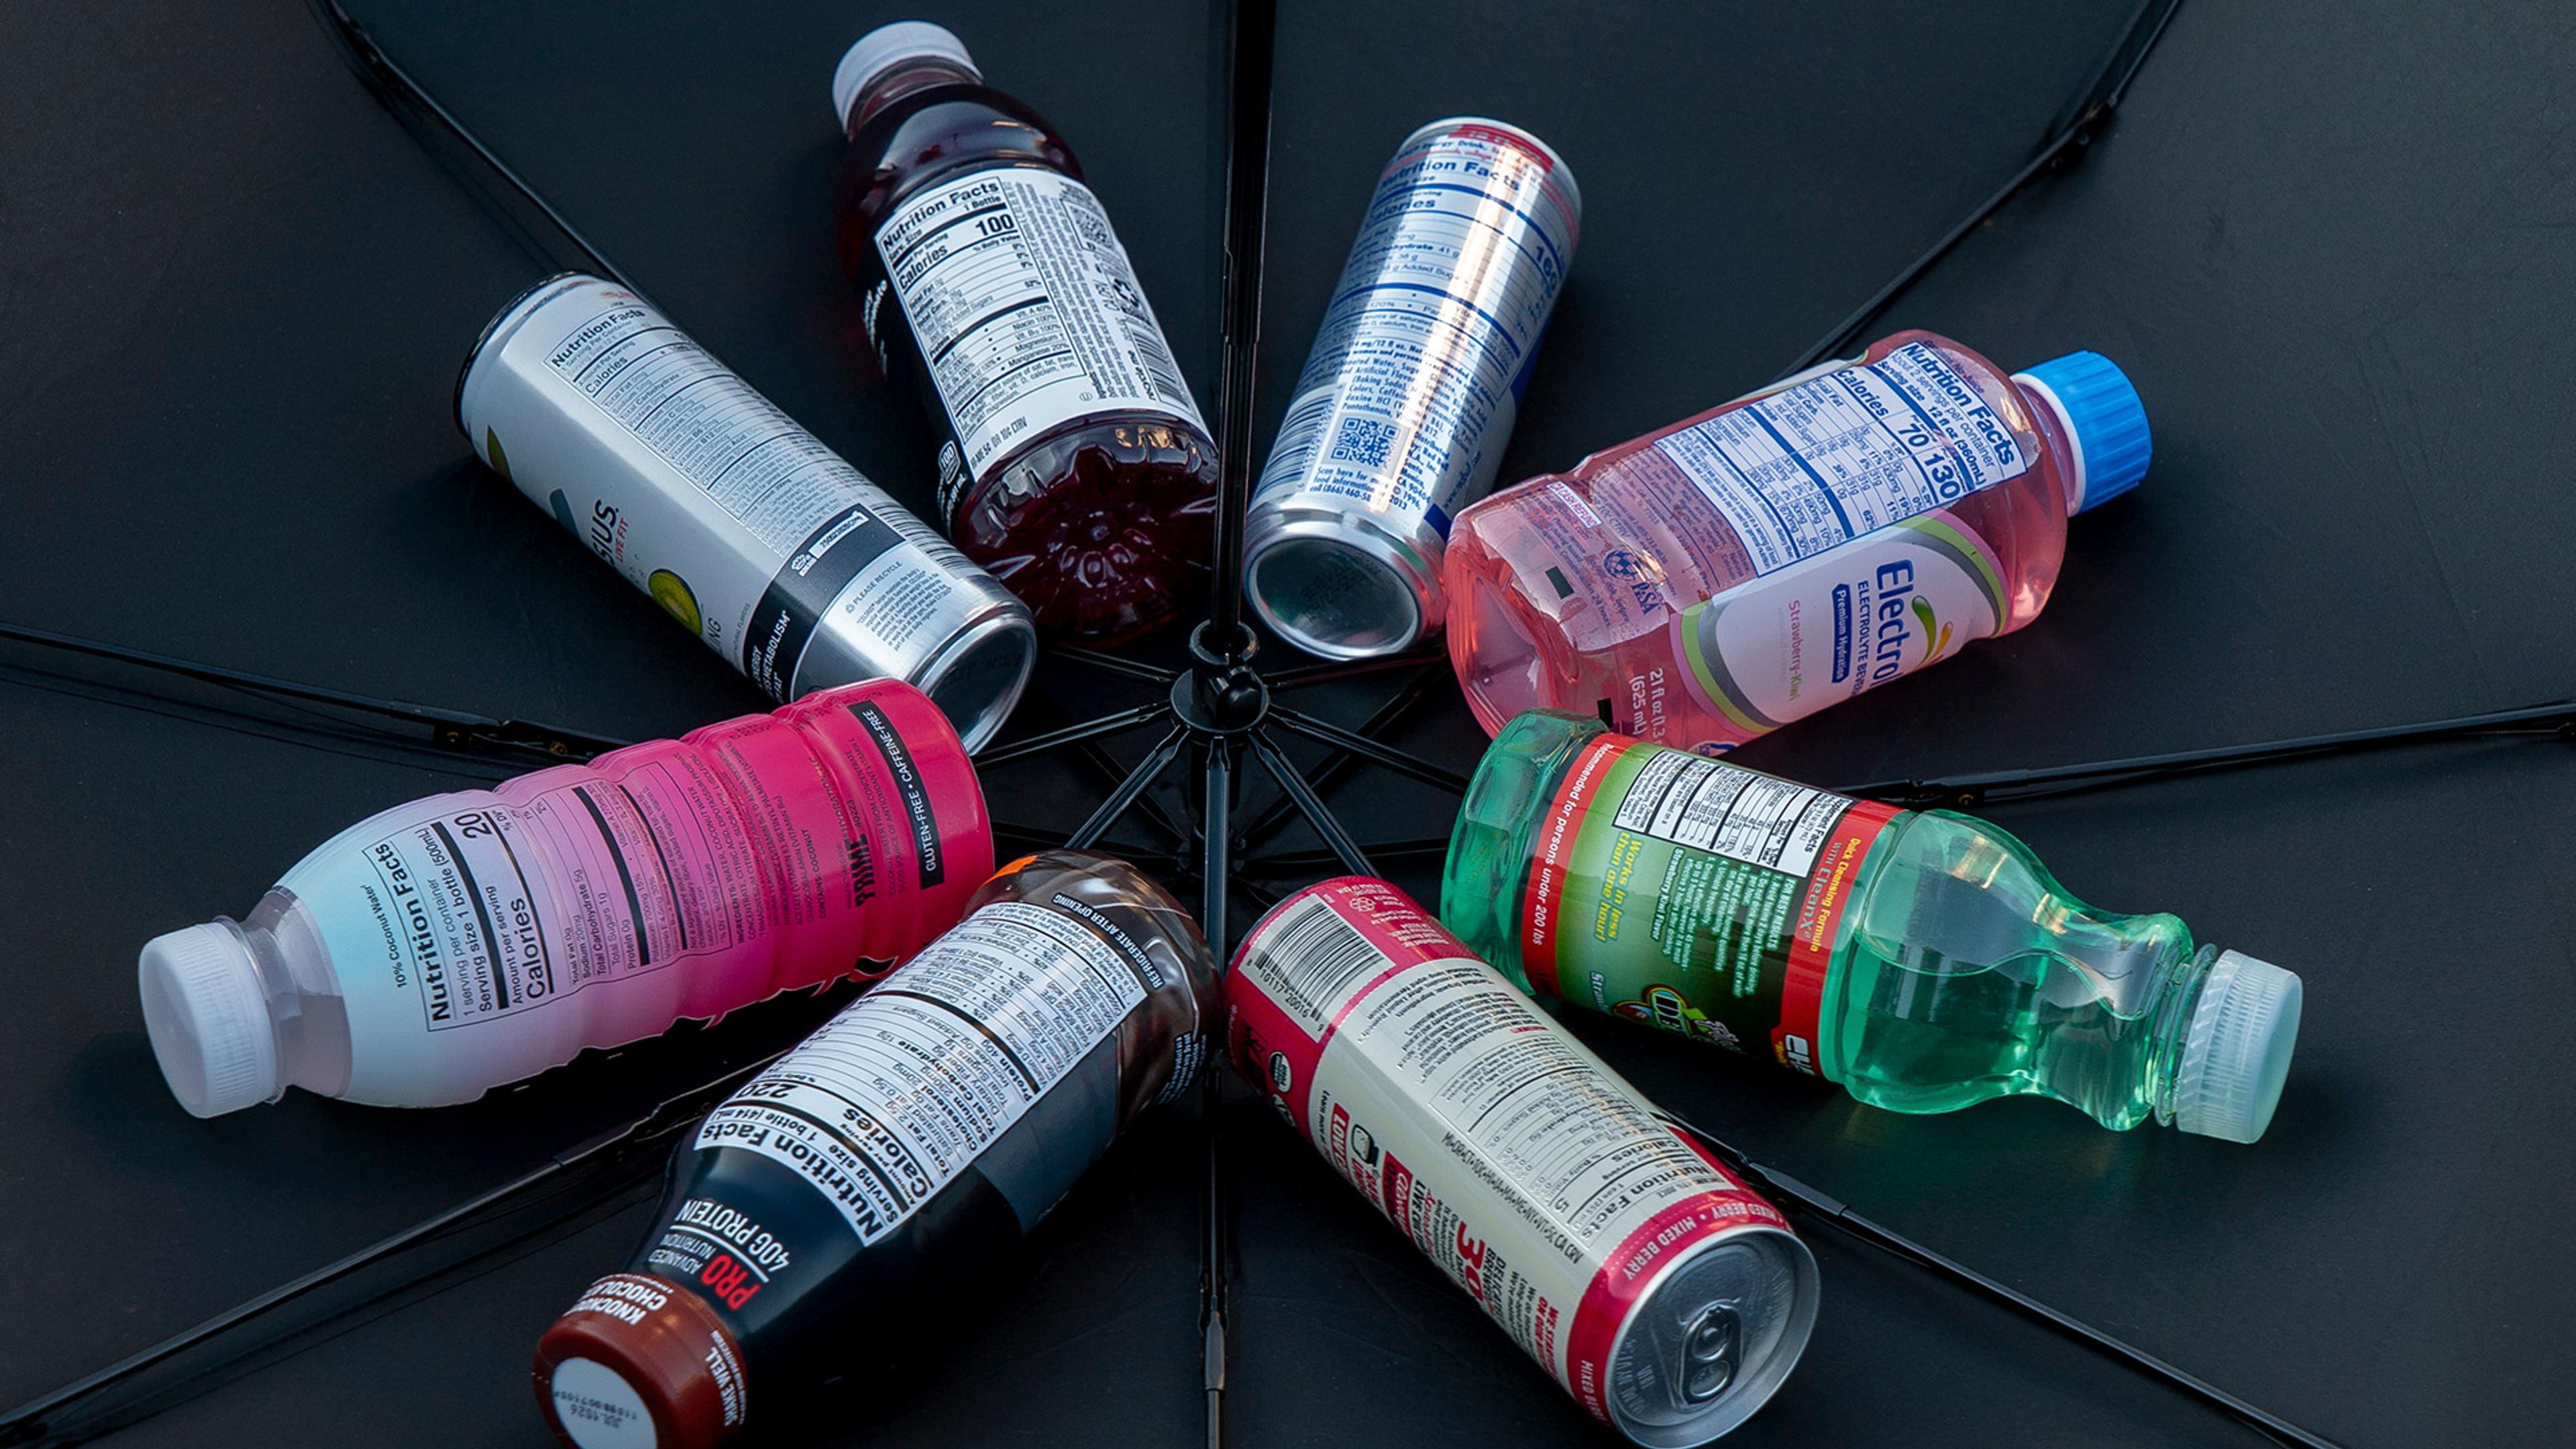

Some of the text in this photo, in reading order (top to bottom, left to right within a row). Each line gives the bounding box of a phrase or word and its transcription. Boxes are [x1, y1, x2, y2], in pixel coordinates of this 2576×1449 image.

[881, 180, 1000, 250] Nutrition Facts
[898, 211, 1016, 289] Calories 100
[551, 309, 645, 368] Nutrition Facts
[584, 354, 629, 394] Calories
[1837, 367, 1965, 502] Calories 70 130
[1901, 340, 2021, 467] Nutrition Facts
[1906, 382, 1957, 439] size 12 fl oz
[1915, 374, 1951, 409] servings
[1945, 406, 1964, 423] per
[1960, 420, 1997, 470] container
[1788, 600, 1801, 700] Strawberry-Kiwi
[1835, 589, 1849, 680] Premium Hydration
[1858, 580, 1868, 661] ELECTROLYTE
[1628, 675, 1648, 735] (625 mL)
[1649, 667, 1664, 716] 21 oz
[862, 708, 938, 871] GLUTEN-FREE CAFFEINE-FREE
[414, 826, 449, 867] (500mL)
[1533, 742, 1614, 946] Recommended for persons under 200 lbs
[1804, 828, 1824, 853] Facts
[1841, 837, 1861, 861] Quick
[439, 867, 465, 906] bottle
[453, 810, 547, 1000] Calories 20
[1594, 832, 1629, 941] than one hour!
[1607, 840, 1642, 938] Works in less
[1652, 848, 1683, 940] Strawberry Kiwi Flavor
[1768, 878, 1794, 949] FOR BEST RESULTS
[1809, 861, 1849, 952] Cleansing Formula
[373, 842, 449, 1022] Nutrition Facts
[374, 914, 407, 987] 10% Coconut
[425, 875, 474, 1006] serving per container
[461, 921, 480, 953] size
[484, 885, 523, 1005] Amount per serving
[578, 883, 606, 975] Total Carbohydrate
[623, 933, 637, 969] Protein
[1051, 892, 1162, 988] REFRIGERATE AFTER OPENING
[471, 954, 492, 1012] Serving
[896, 1037, 998, 1135] Total Carbohydrate
[998, 1057, 1033, 1102] Protein
[763, 1110, 857, 1170] size bottle
[842, 1106, 930, 1200] Calories
[894, 1093, 955, 1157] Saturated Fat
[907, 1121, 951, 1177] Total Fat
[920, 1083, 979, 1152] Cholesterol
[951, 1096, 989, 1142] Sodium
[1611, 1138, 1678, 1165] Calories
[701, 1123, 883, 1240] Nutrition Facts
[1580, 1164, 1710, 1240] Nutrition Facts
[674, 1198, 793, 1277] 40G PROTEIN
[1621, 1217, 1696, 1281] MIXED BERRY
[698, 1249, 761, 1316] PRO
[702, 1346, 733, 1389] WELL
